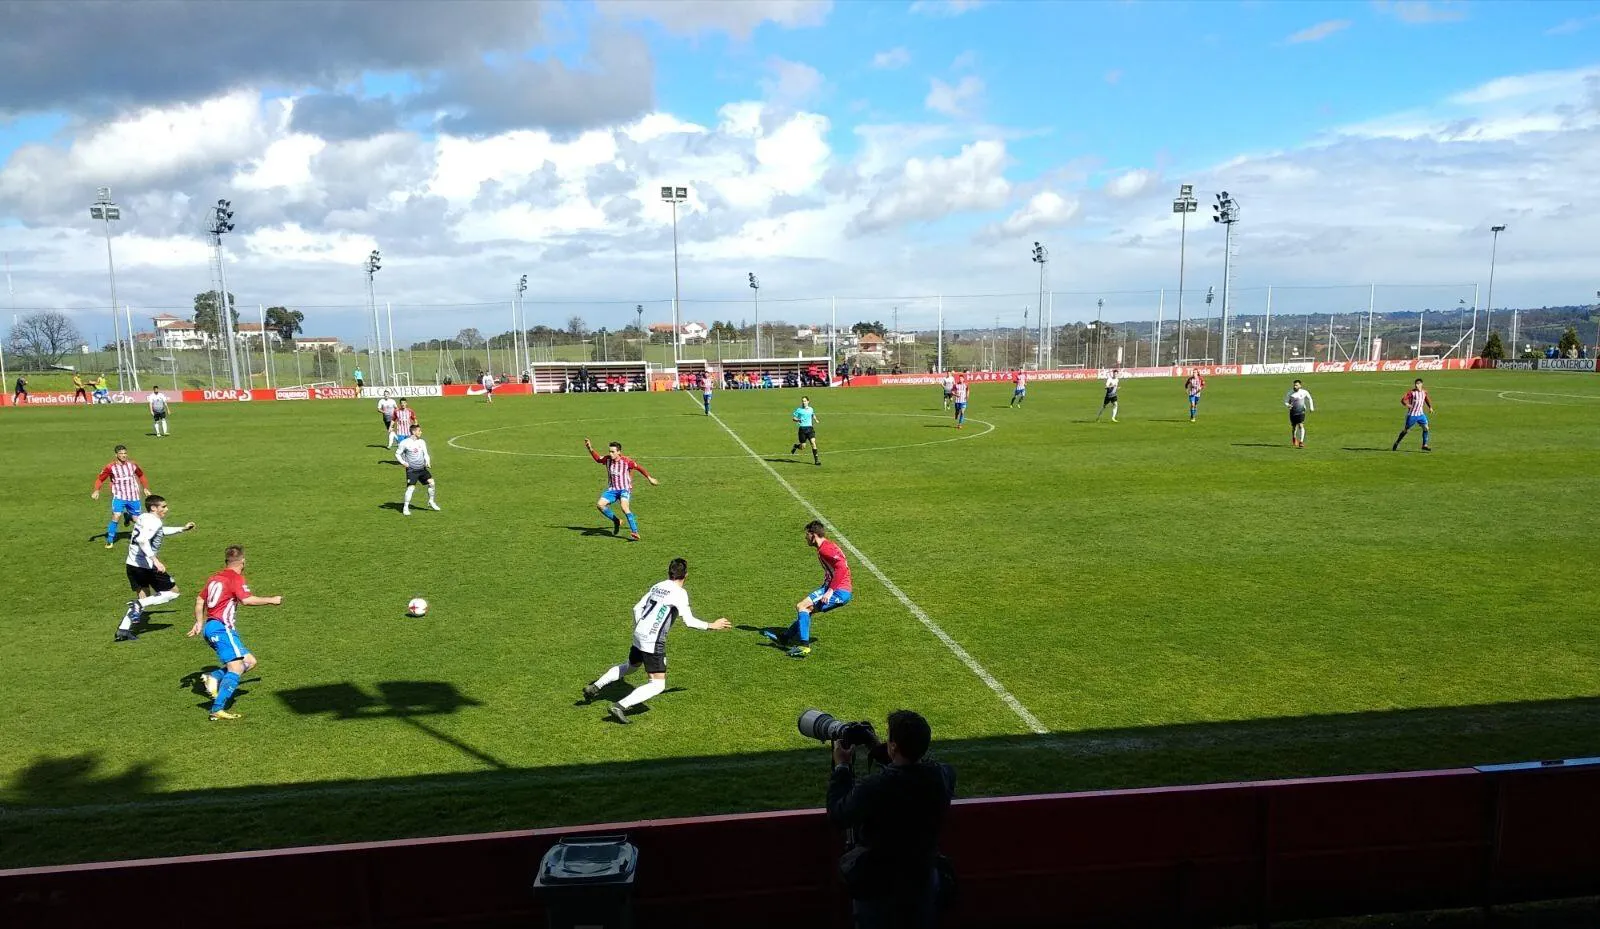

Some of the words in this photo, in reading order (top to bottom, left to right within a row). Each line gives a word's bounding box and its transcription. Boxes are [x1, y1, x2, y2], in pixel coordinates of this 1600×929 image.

[1551, 360, 1594, 369] COMERCIO
[967, 372, 1013, 381] HARRYS
[203, 390, 238, 400] DICAR
[322, 388, 355, 396] CASINO
[26, 395, 57, 404] Tienda
